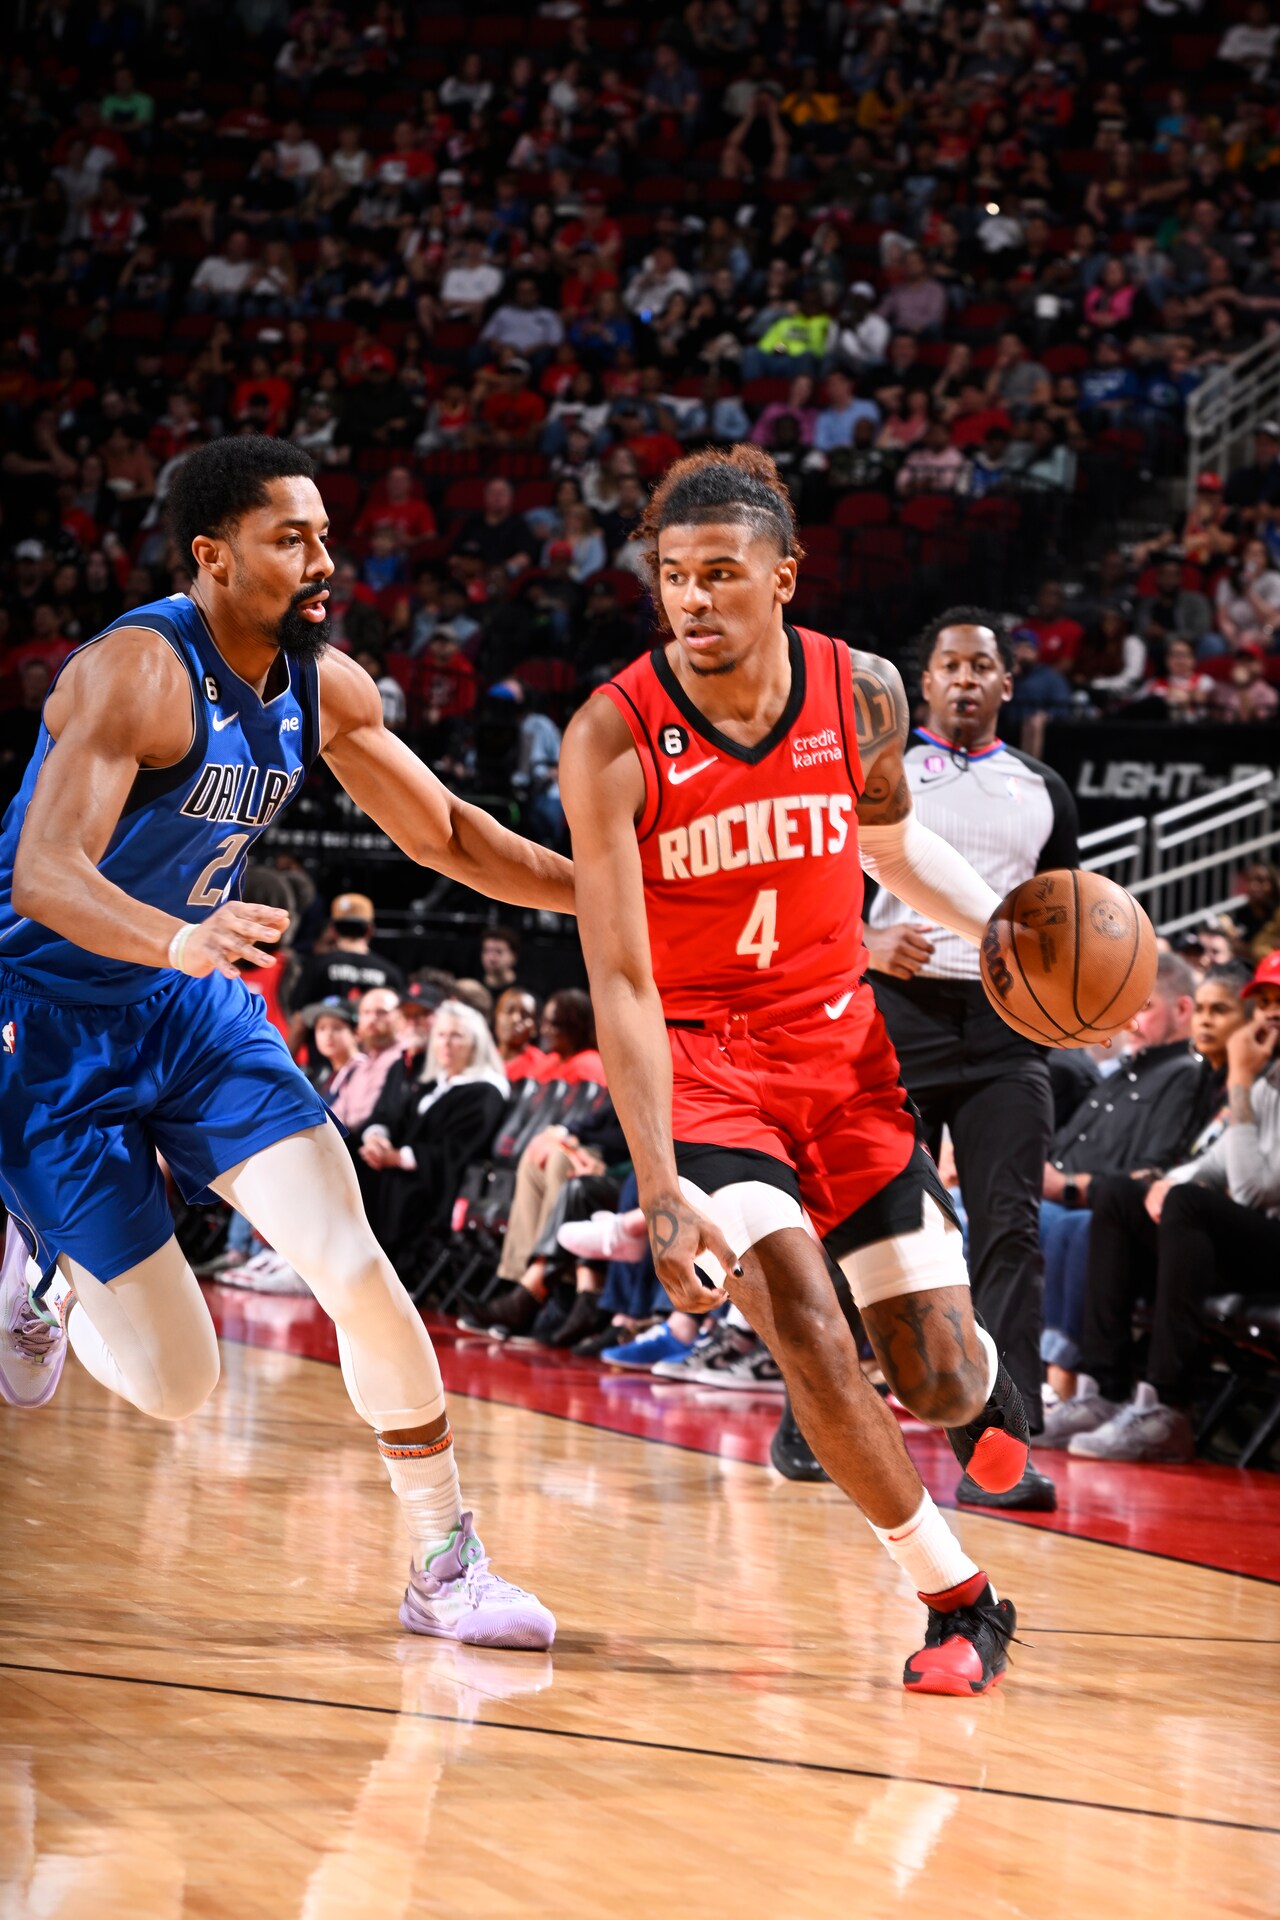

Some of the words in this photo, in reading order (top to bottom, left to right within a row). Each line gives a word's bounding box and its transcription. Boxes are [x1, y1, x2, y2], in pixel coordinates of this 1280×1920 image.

[204, 676, 219, 701] 6
[663, 727, 683, 755] 6
[793, 728, 838, 751] credit
[793, 747, 842, 769] karma
[1077, 761, 1204, 799] LIGHT
[658, 793, 853, 881] ROCKETS
[736, 888, 780, 970] 4
